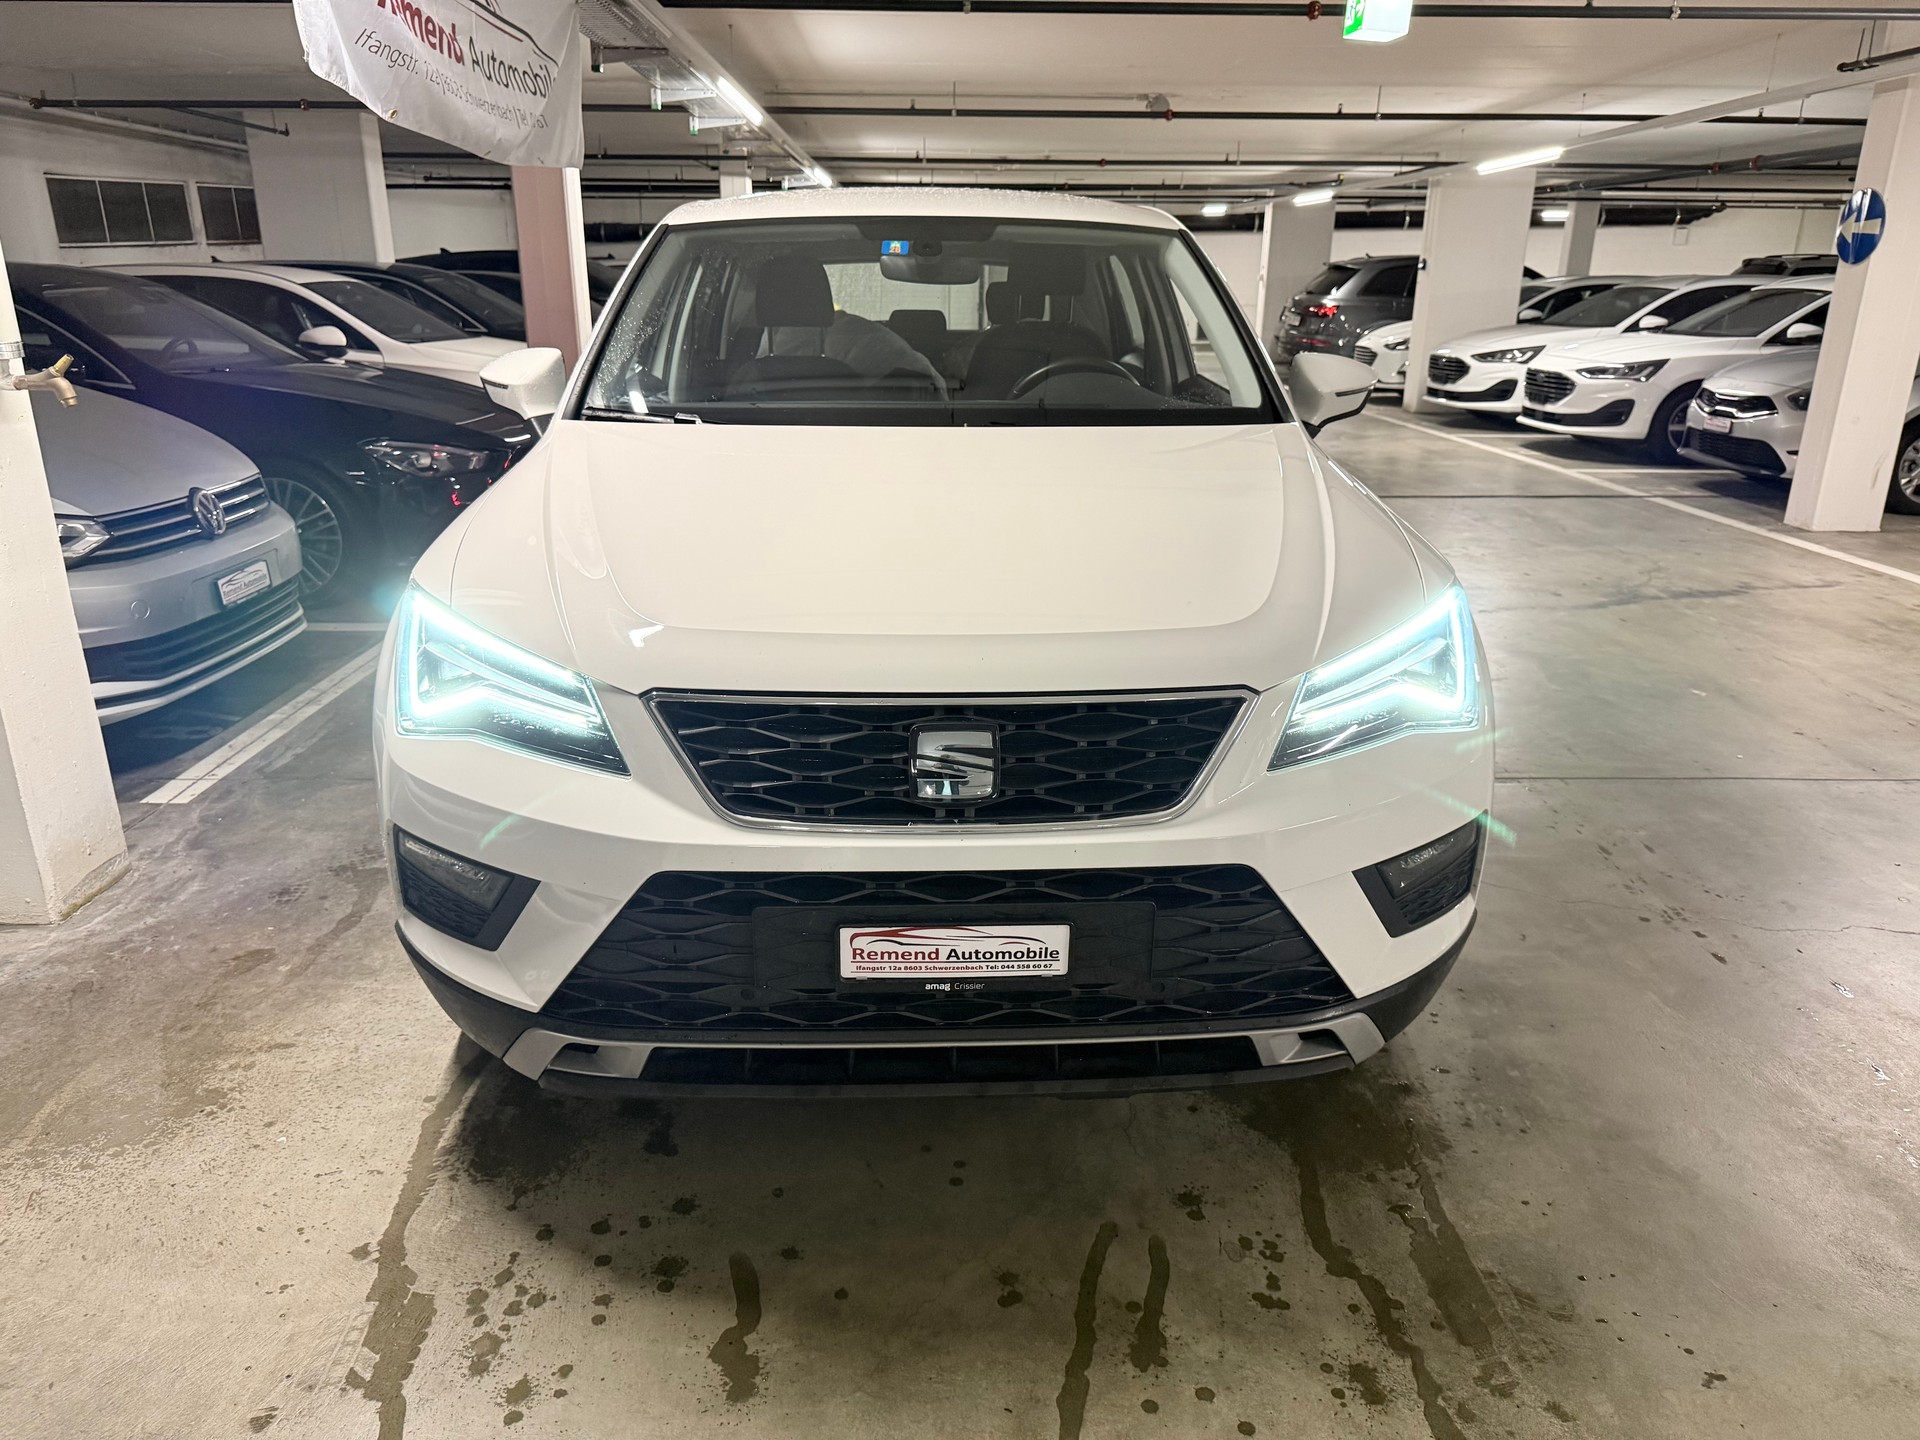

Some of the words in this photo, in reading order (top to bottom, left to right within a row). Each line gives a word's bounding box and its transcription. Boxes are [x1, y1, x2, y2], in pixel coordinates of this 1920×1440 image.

[354, 28, 419, 75] Ifangstr.
[469, 35, 557, 99] Automobil
[852, 948, 940, 960] Remend
[946, 947, 1060, 960] Automobile
[925, 982, 951, 992] amag
[954, 982, 986, 990] Crissier
